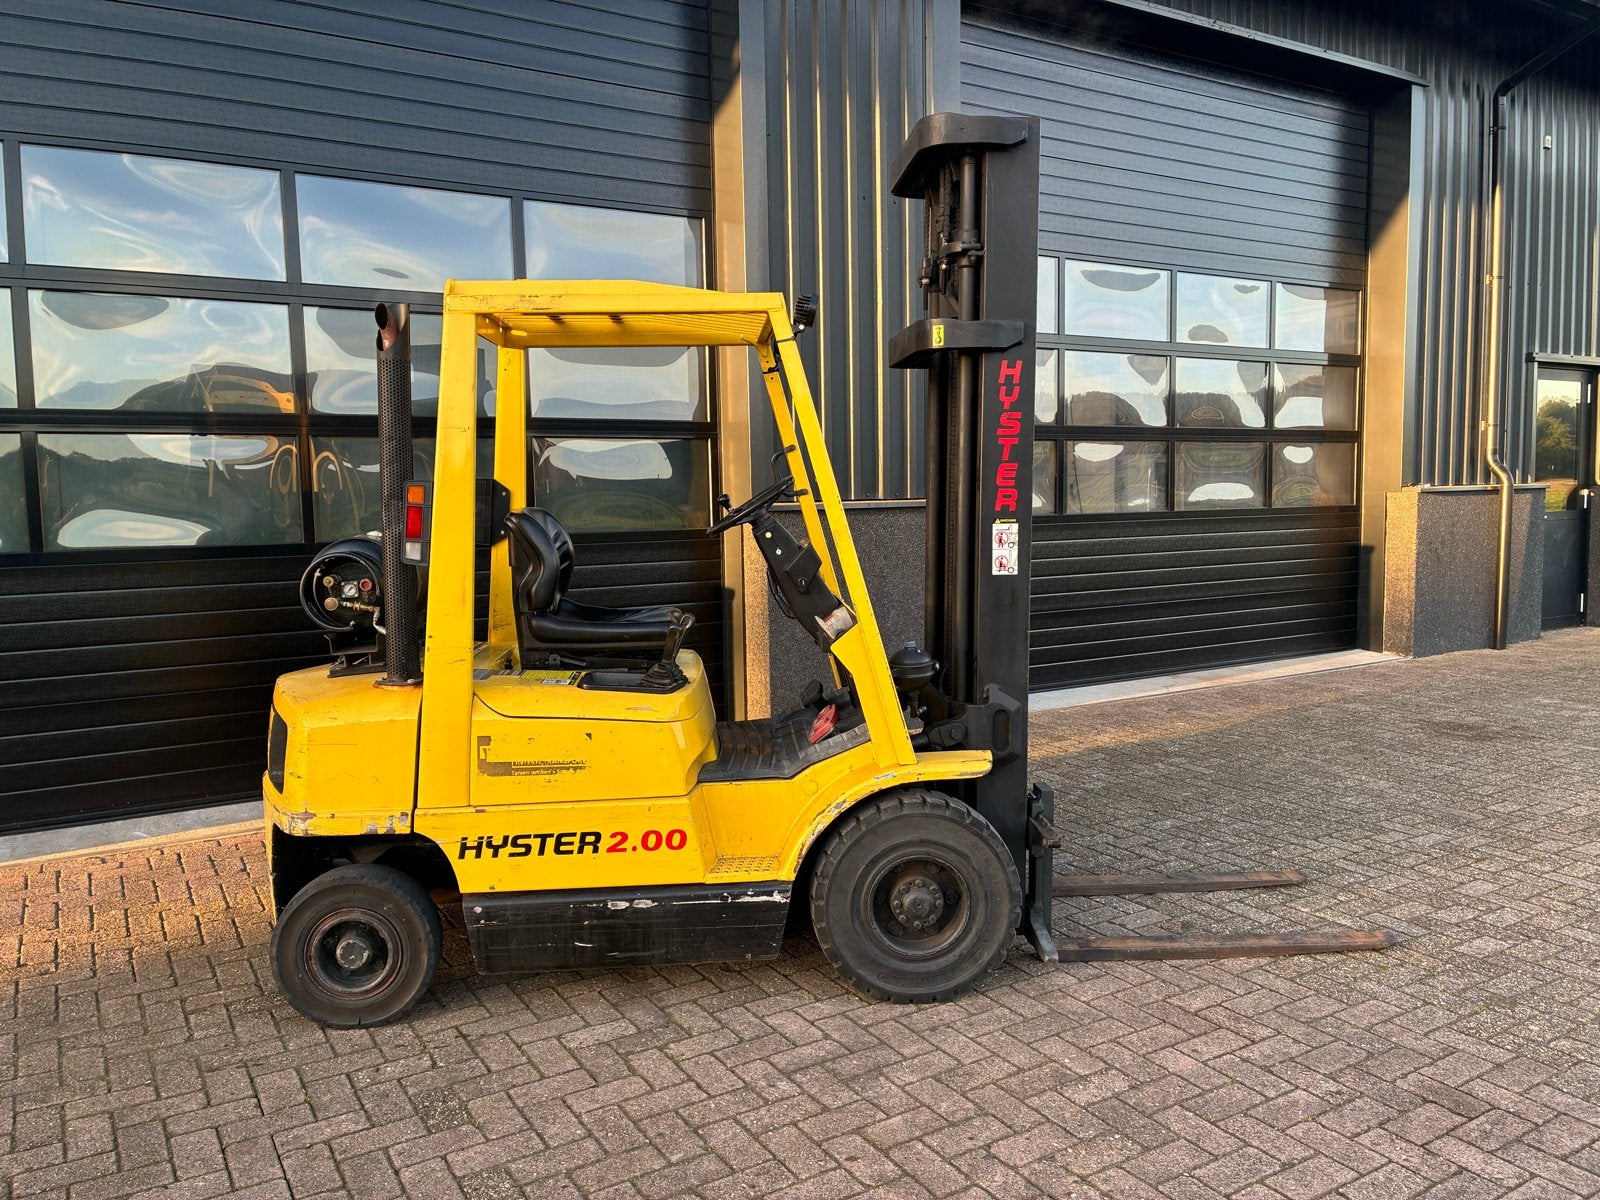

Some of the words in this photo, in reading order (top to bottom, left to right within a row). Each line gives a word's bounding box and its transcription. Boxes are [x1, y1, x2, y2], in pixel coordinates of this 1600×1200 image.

[995, 359, 1023, 511] HYSTER
[458, 831, 602, 860] HYSTER
[606, 828, 688, 853] 2.00
